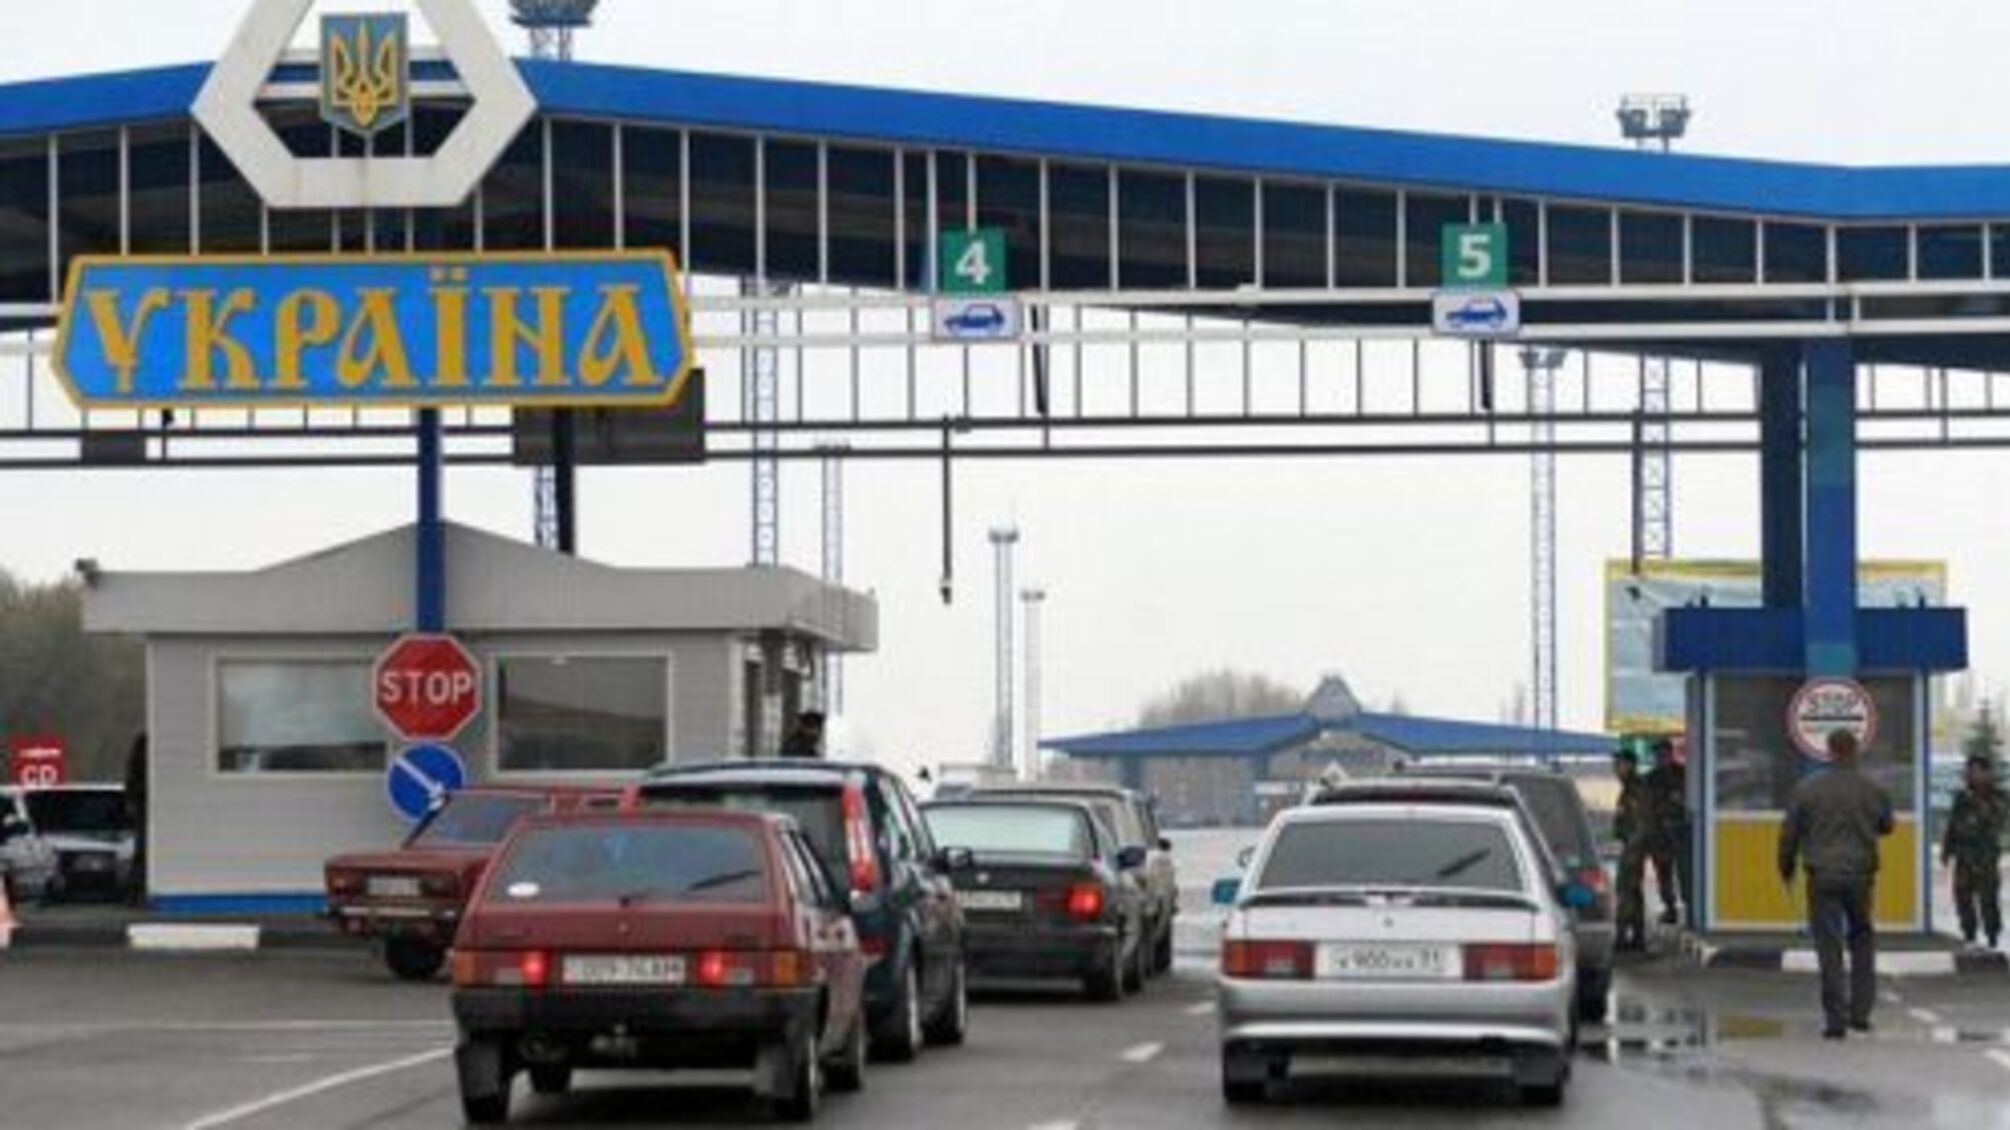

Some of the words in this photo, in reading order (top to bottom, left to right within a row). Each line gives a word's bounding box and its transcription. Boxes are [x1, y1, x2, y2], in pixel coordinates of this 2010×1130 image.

[955, 240, 991, 284] 4
[1458, 234, 1491, 277] 5
[86, 267, 664, 391] УКРАЇНА
[383, 671, 472, 704] STOP
